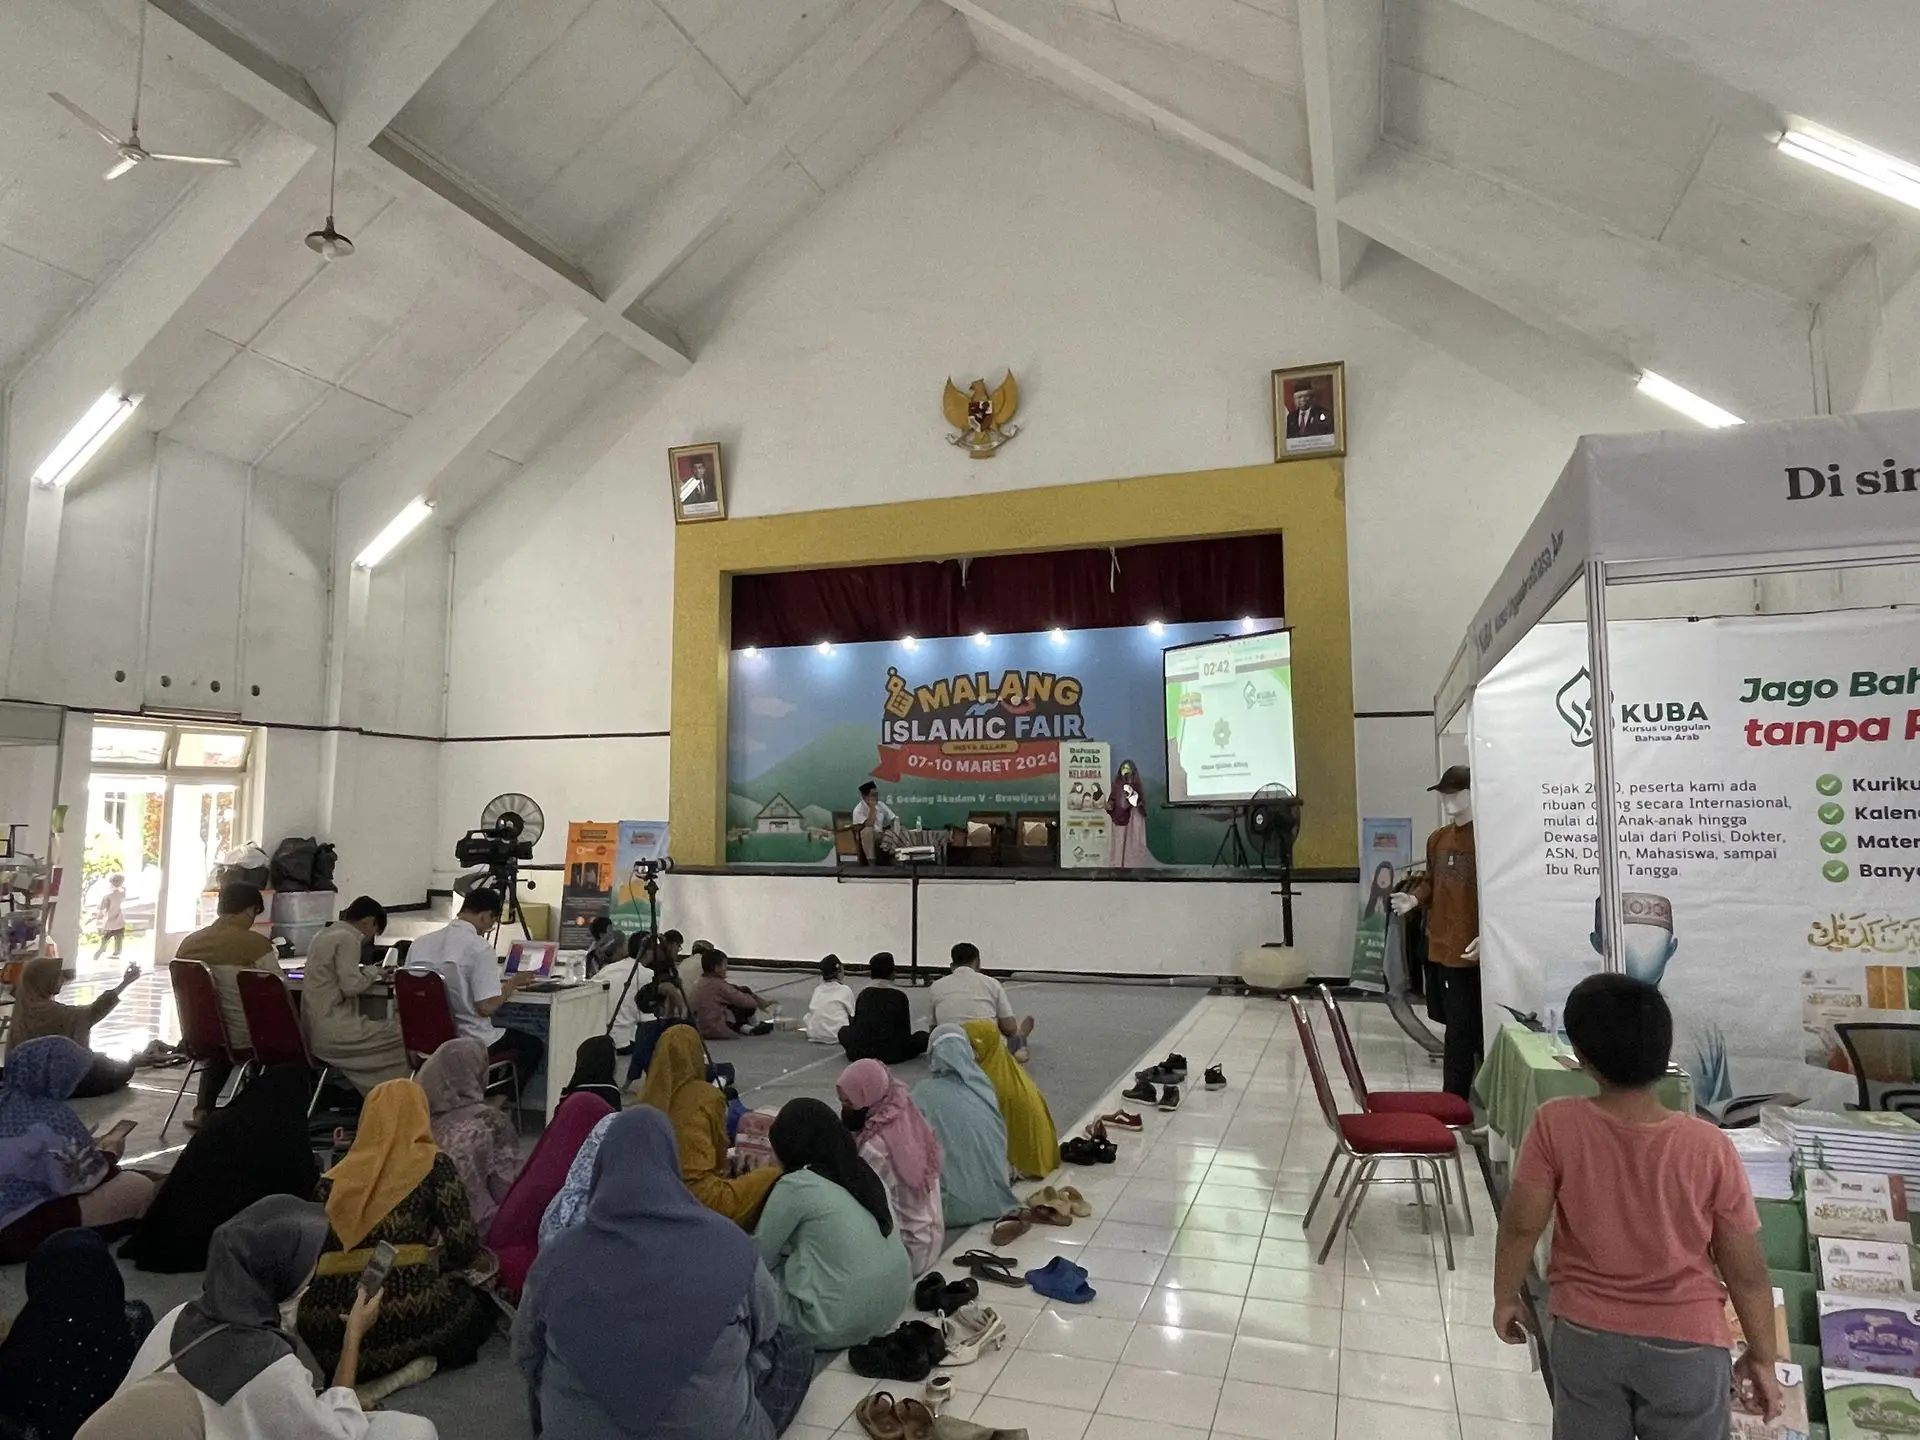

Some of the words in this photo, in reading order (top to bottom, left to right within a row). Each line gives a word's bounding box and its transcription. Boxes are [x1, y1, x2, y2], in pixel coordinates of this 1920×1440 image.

[1784, 463, 1845, 500] Di
[914, 671, 1083, 713] MALANG
[1739, 677, 1839, 707] Jago
[1621, 701, 1709, 724] KUBA
[884, 716, 1006, 743] ISLAMIC
[1014, 714, 1083, 739] FAIR
[1622, 724, 1658, 733] Kursus
[1659, 723, 1711, 733] Unggulan
[1744, 717, 1891, 751] tanpa
[1635, 734, 1673, 742] Bahasa
[1675, 733, 1700, 741] Arab
[907, 754, 953, 772] 07-10
[955, 758, 1011, 773] MARET
[1016, 751, 1057, 770] 2024
[1070, 754, 1101, 764] Arab
[1541, 782, 1580, 796] Sejak
[1629, 782, 1684, 796] peserta
[1689, 780, 1725, 793] kami
[1730, 780, 1757, 792] ada
[1542, 799, 1586, 810] ribuan
[1636, 800, 1684, 810] secara
[1689, 796, 1792, 811] Internasional,
[1855, 805, 1920, 820] Kalen
[1543, 815, 1581, 827] mulai
[1618, 814, 1693, 826] Anak-anak
[1698, 813, 1747, 829] hingga
[1544, 831, 1598, 843] Dewasa
[1619, 830, 1645, 843] ulai
[1649, 829, 1677, 843] dari
[1682, 831, 1726, 844] Polisi,
[1730, 829, 1786, 844] Dokter,
[1545, 847, 1579, 860] ASN,
[1636, 846, 1719, 861] Mahasiswa,
[1723, 848, 1777, 861] sampai
[1546, 864, 1568, 875] Ibu
[1859, 864, 1920, 882] Bany
